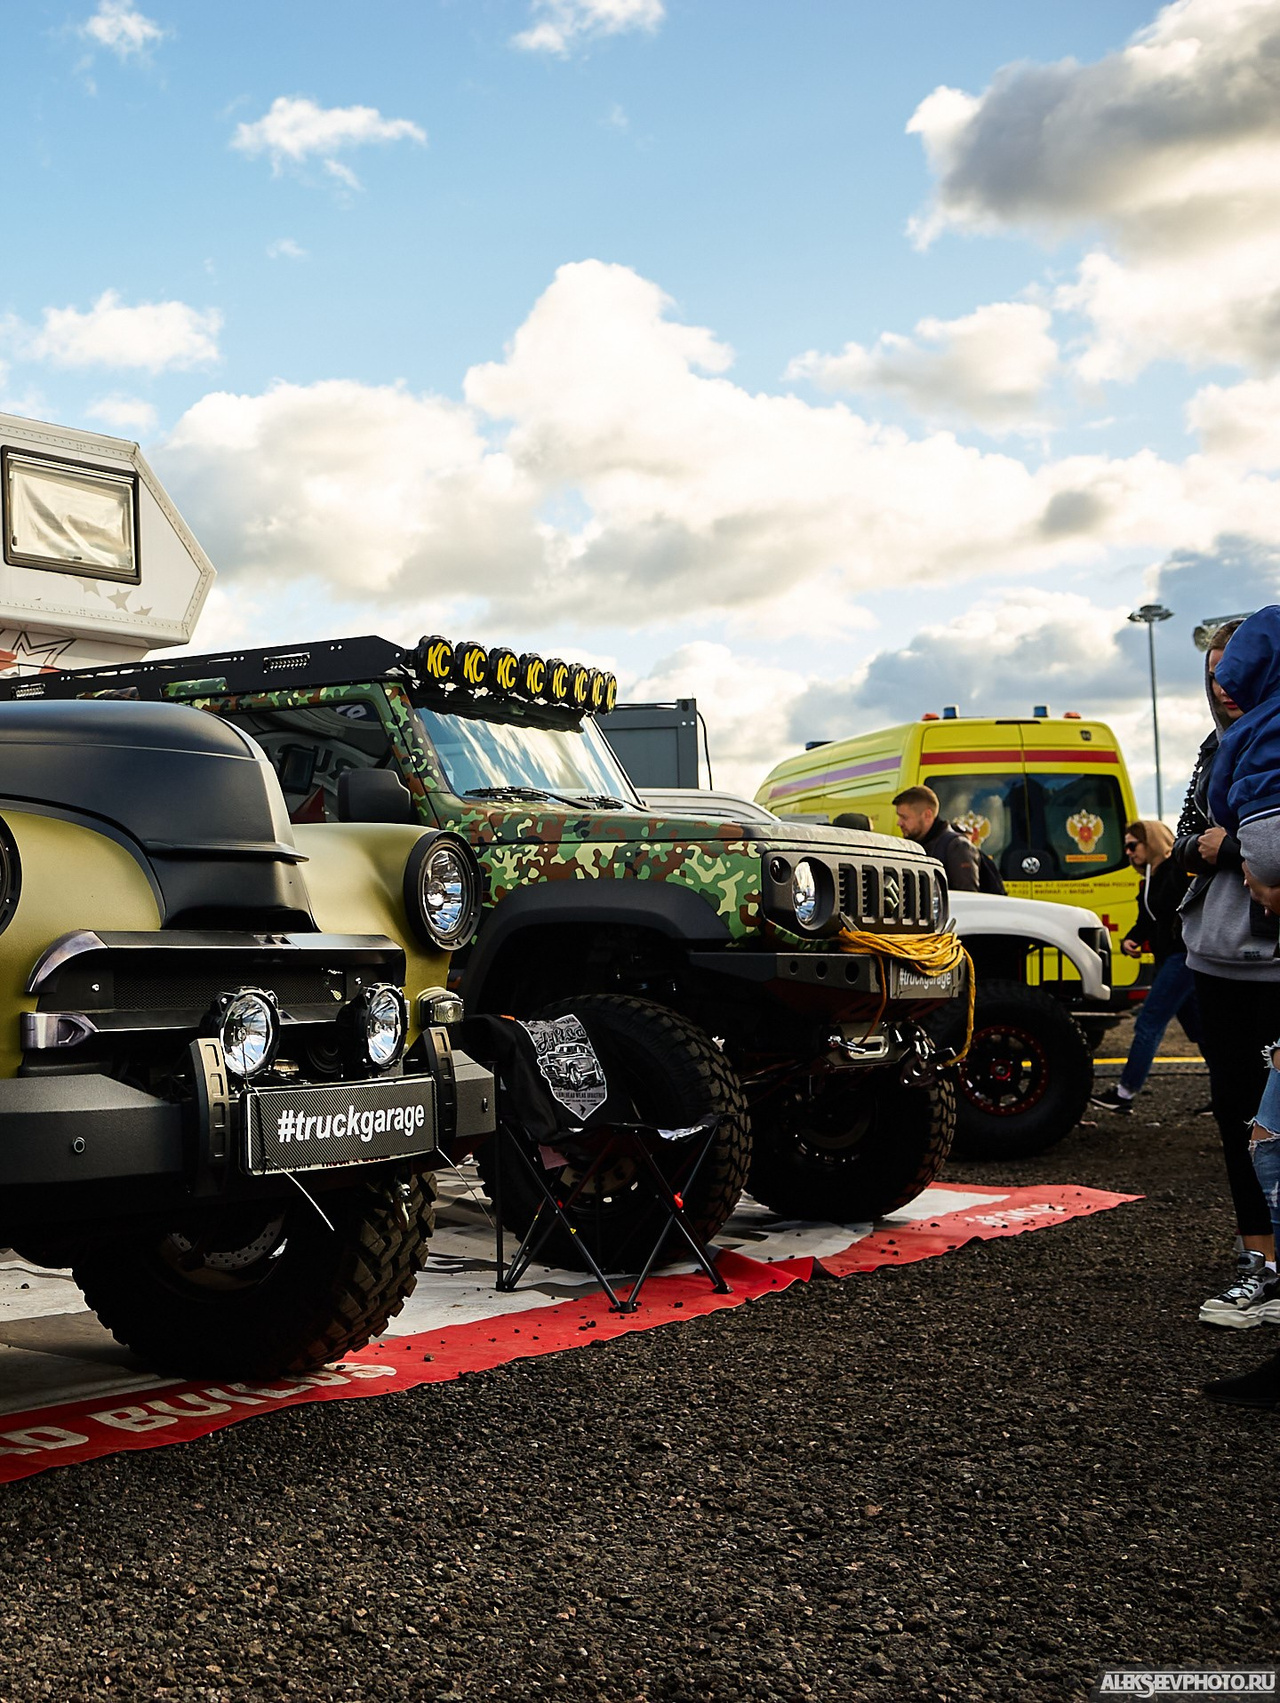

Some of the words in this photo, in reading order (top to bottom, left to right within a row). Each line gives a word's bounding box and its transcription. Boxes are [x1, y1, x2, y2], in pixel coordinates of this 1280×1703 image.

[427, 642, 451, 678] KC
[463, 648, 486, 684] KC
[496, 654, 517, 689] KC
[526, 660, 545, 694] KC
[552, 665, 568, 699] KC
[574, 669, 588, 703] KC
[592, 673, 604, 706] KC
[607, 677, 617, 709] KC
[277, 1104, 425, 1143] #truckgarage
